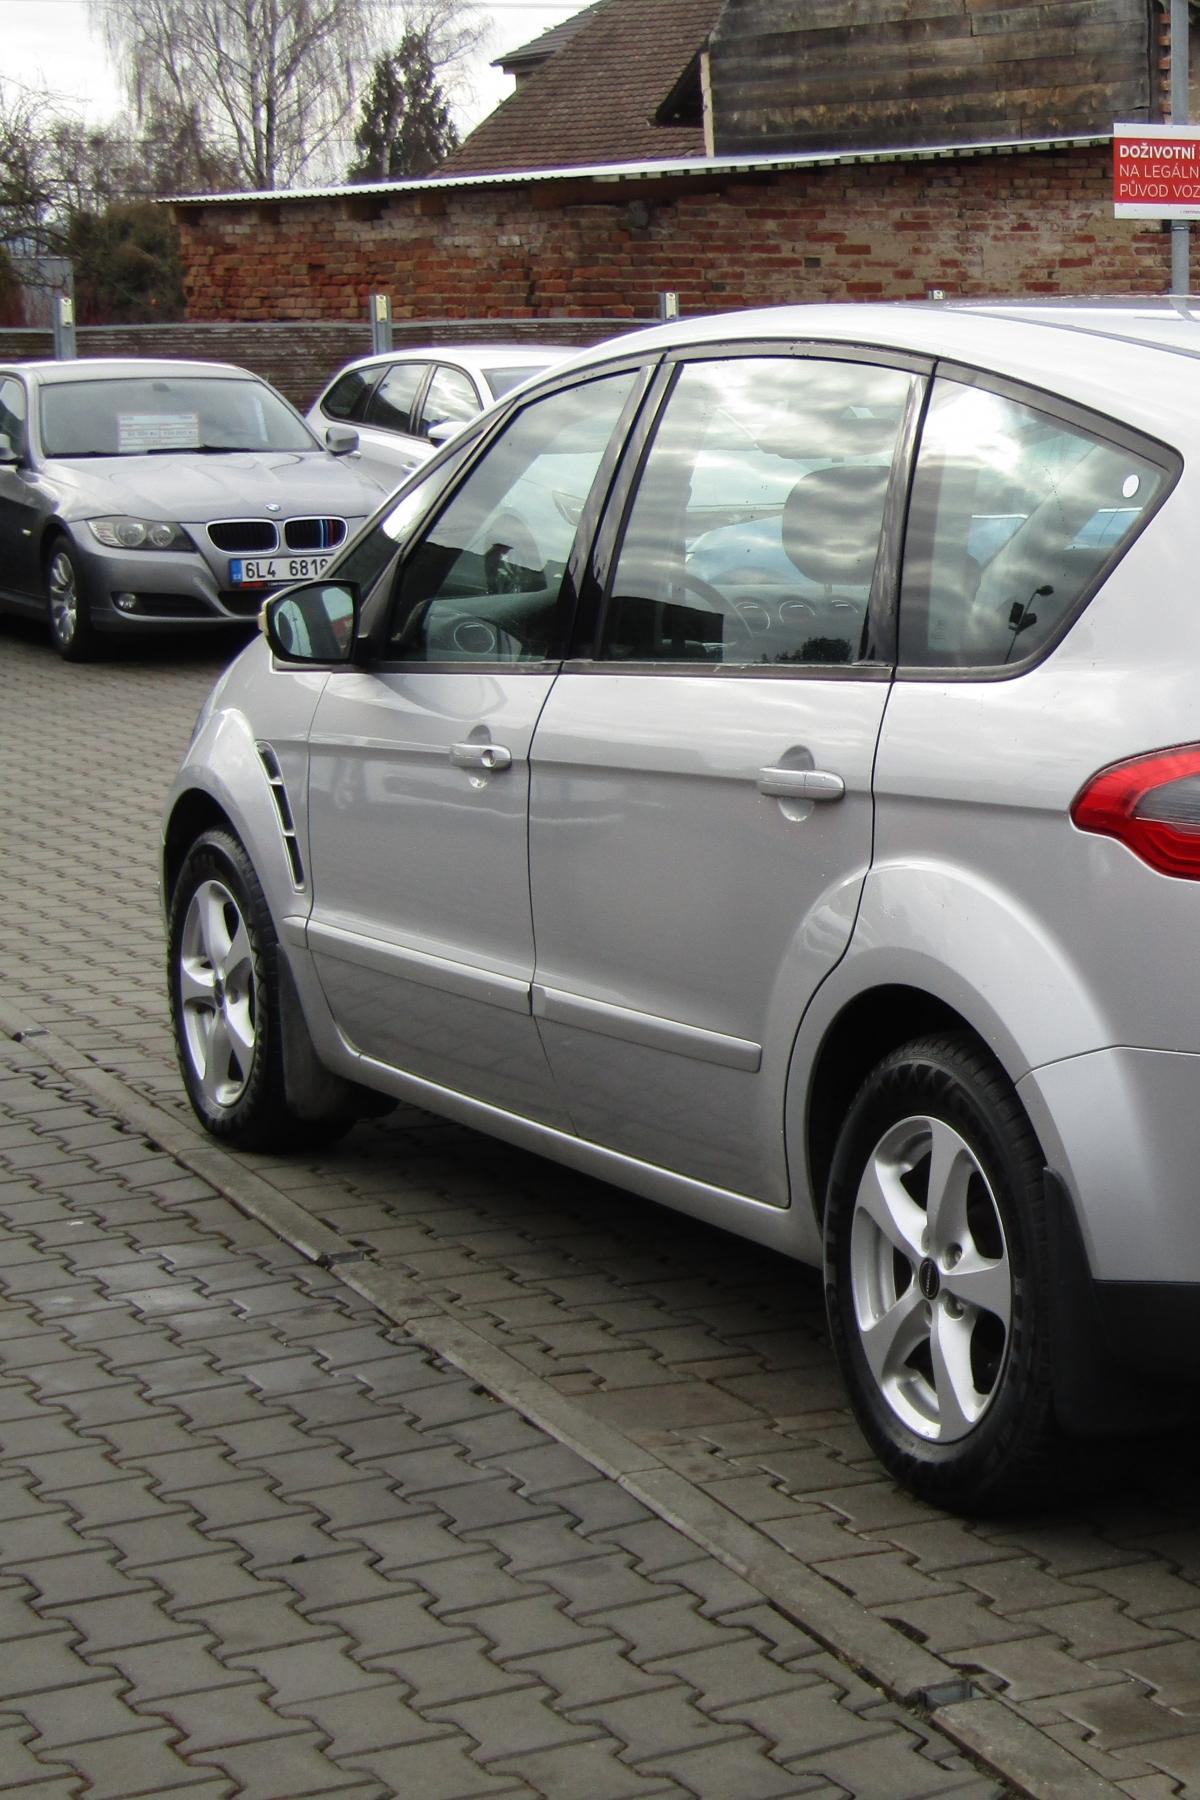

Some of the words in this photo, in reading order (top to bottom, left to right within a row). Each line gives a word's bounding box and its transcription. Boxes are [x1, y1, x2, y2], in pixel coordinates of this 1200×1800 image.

[1119, 143, 1195, 160] DOŽIVOTNÍ
[1119, 164, 1140, 177] NA
[1119, 180, 1169, 198] PŮVOD
[245, 561, 276, 579] 6L4
